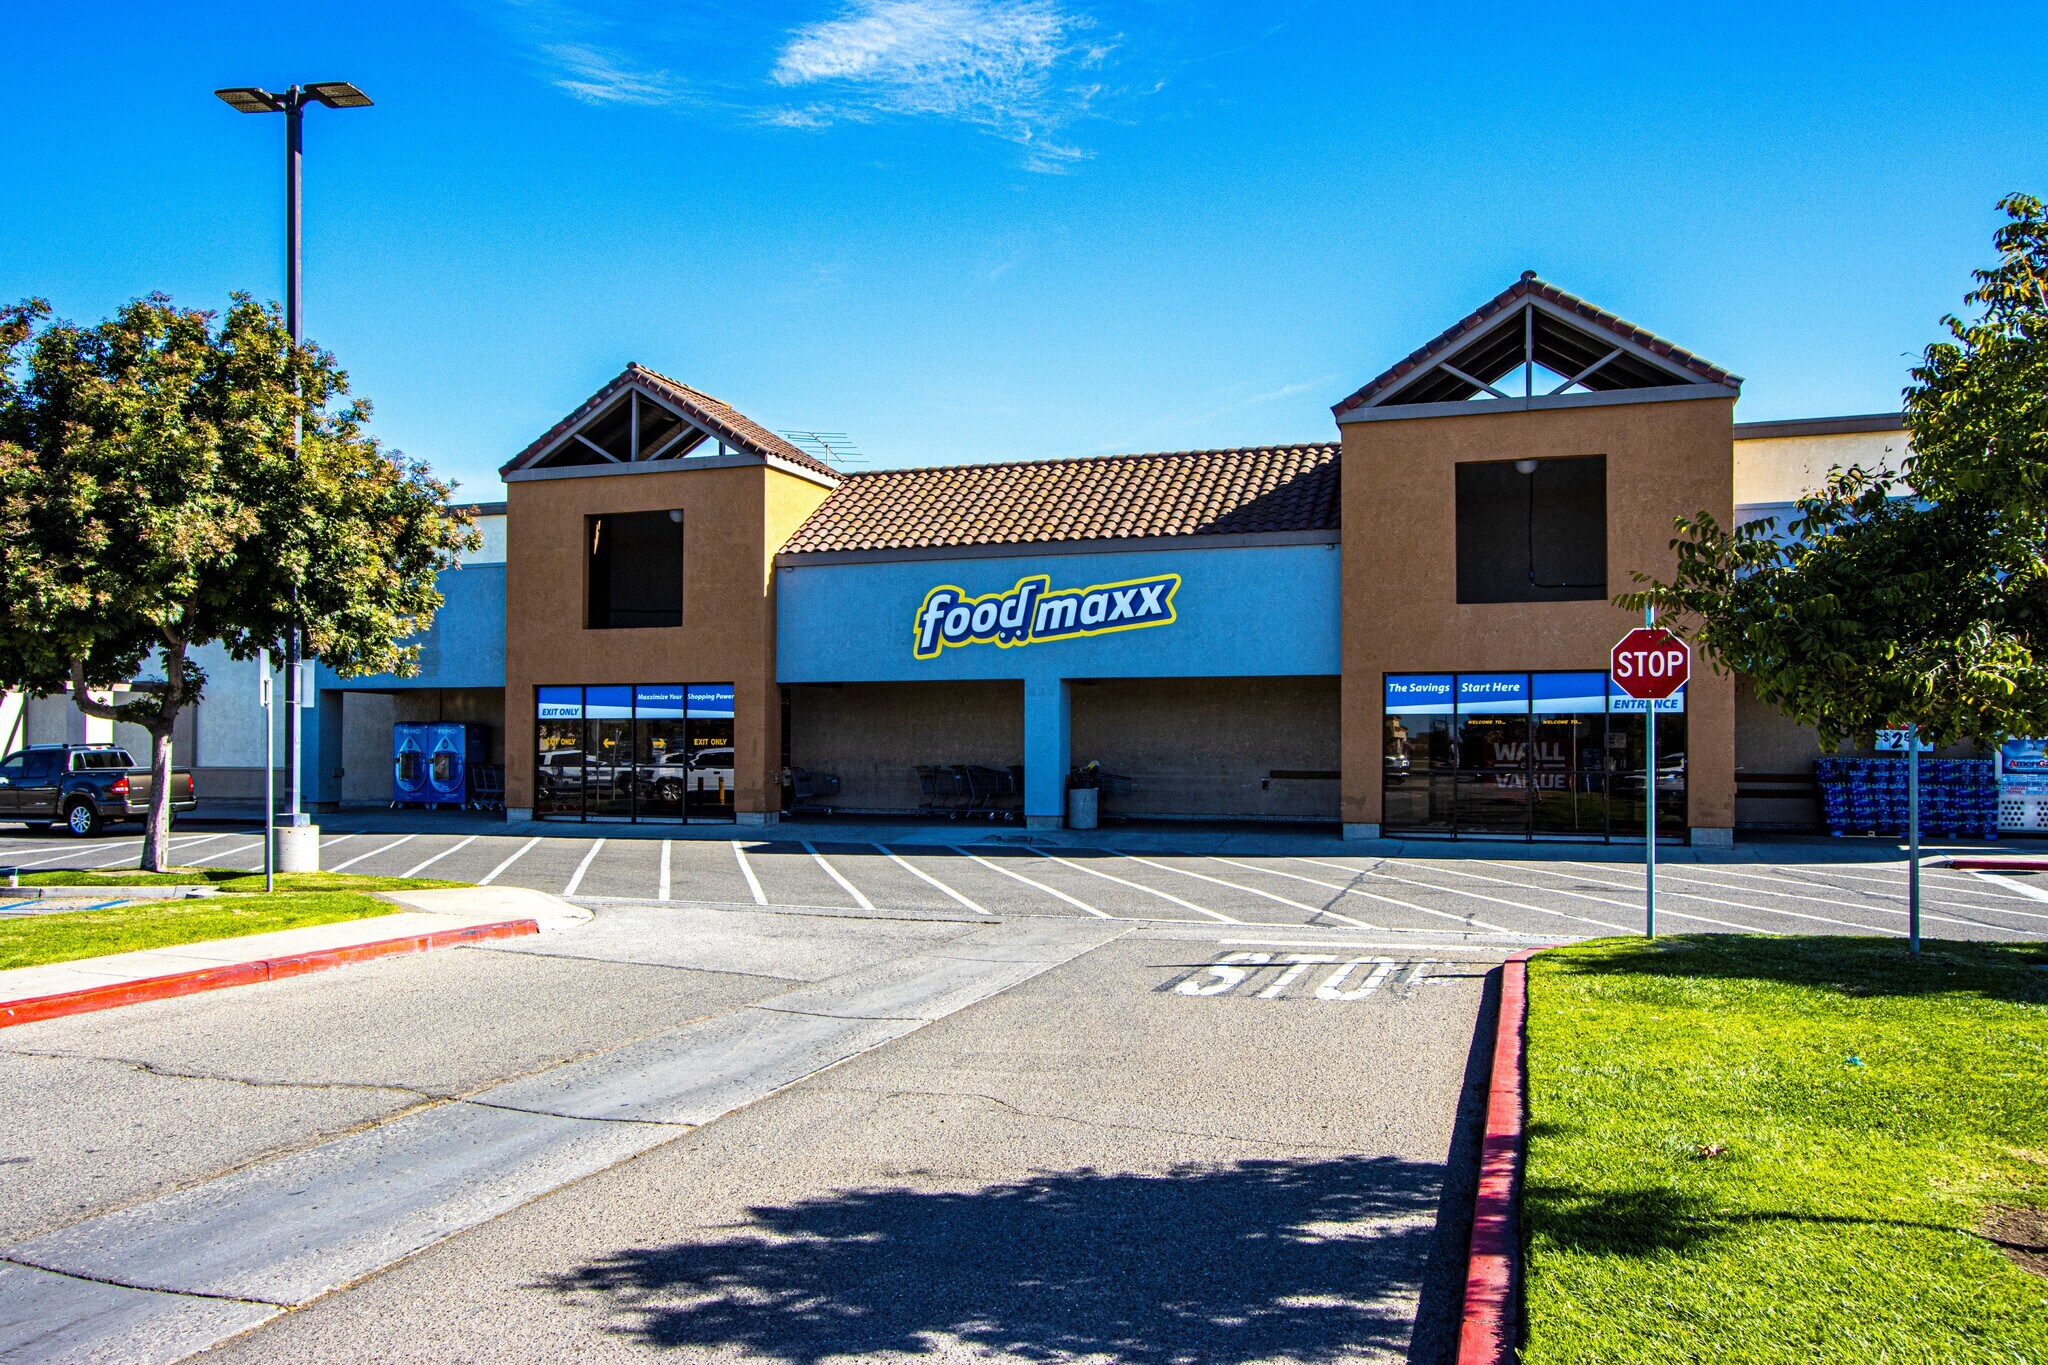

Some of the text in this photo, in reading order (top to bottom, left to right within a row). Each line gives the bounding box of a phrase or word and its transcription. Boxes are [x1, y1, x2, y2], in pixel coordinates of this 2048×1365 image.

[921, 584, 1165, 648] food maxx
[1617, 651, 1684, 677] STOP
[1389, 682, 1520, 694] The Savings Start Here
[687, 692, 715, 701] Shopping
[1613, 699, 1679, 709] ENTRNCE
[542, 708, 580, 716] EXIT ONLY
[560, 738, 576, 746] ONLY
[694, 738, 728, 746] EXIT ONLY
[1494, 742, 1566, 760] WALL
